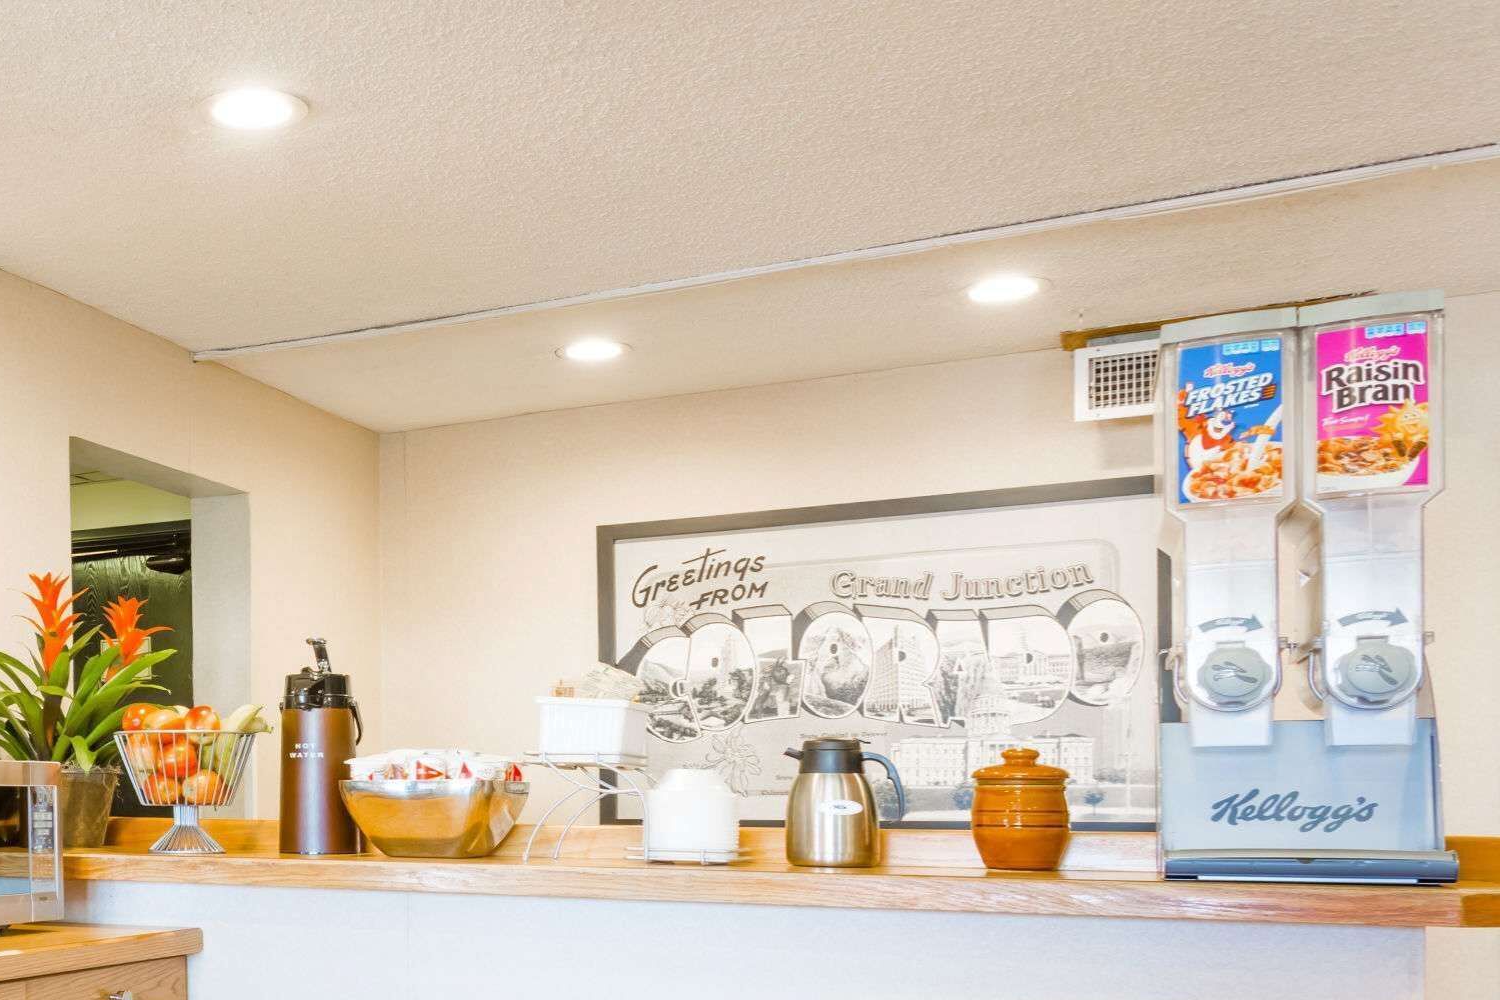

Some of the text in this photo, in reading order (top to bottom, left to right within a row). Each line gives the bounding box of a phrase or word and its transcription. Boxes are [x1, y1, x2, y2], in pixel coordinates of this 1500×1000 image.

[1185, 373, 1273, 406] FROSTED
[1325, 361, 1421, 392] Raisin
[1187, 387, 1261, 417] FLAKES
[1336, 384, 1411, 410] Bran
[689, 581, 769, 610] FROM
[829, 561, 1094, 600] Grand Junction
[1211, 788, 1379, 833] Kellogg's
